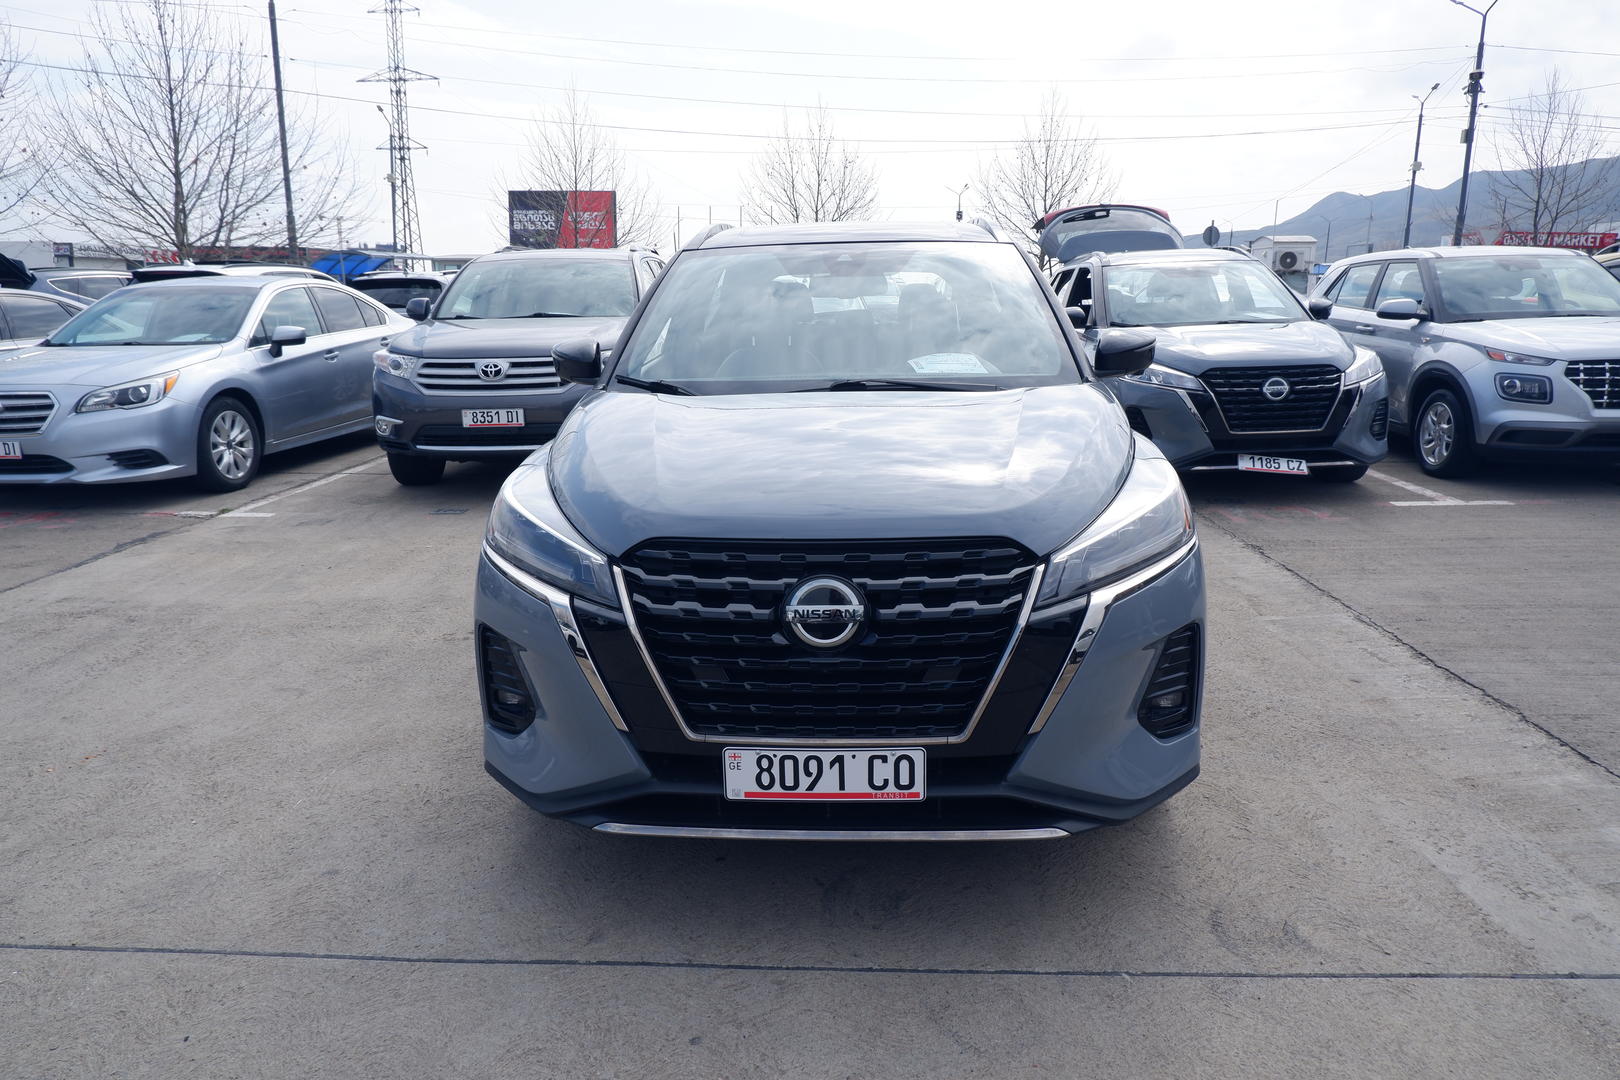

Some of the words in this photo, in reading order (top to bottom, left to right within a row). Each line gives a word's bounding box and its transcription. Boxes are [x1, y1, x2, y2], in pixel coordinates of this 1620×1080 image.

[1553, 233, 1603, 247] MARKET
[471, 411, 501, 424] 8351
[506, 410, 519, 423] DI
[2, 442, 17, 455] DI
[1249, 456, 1281, 470] 1185
[1286, 459, 1305, 472] CZ
[793, 609, 856, 619] NISSAN
[728, 761, 742, 771] GE
[755, 753, 846, 792] 8091
[867, 753, 916, 792] CO
[871, 792, 909, 800] TRANSIT
